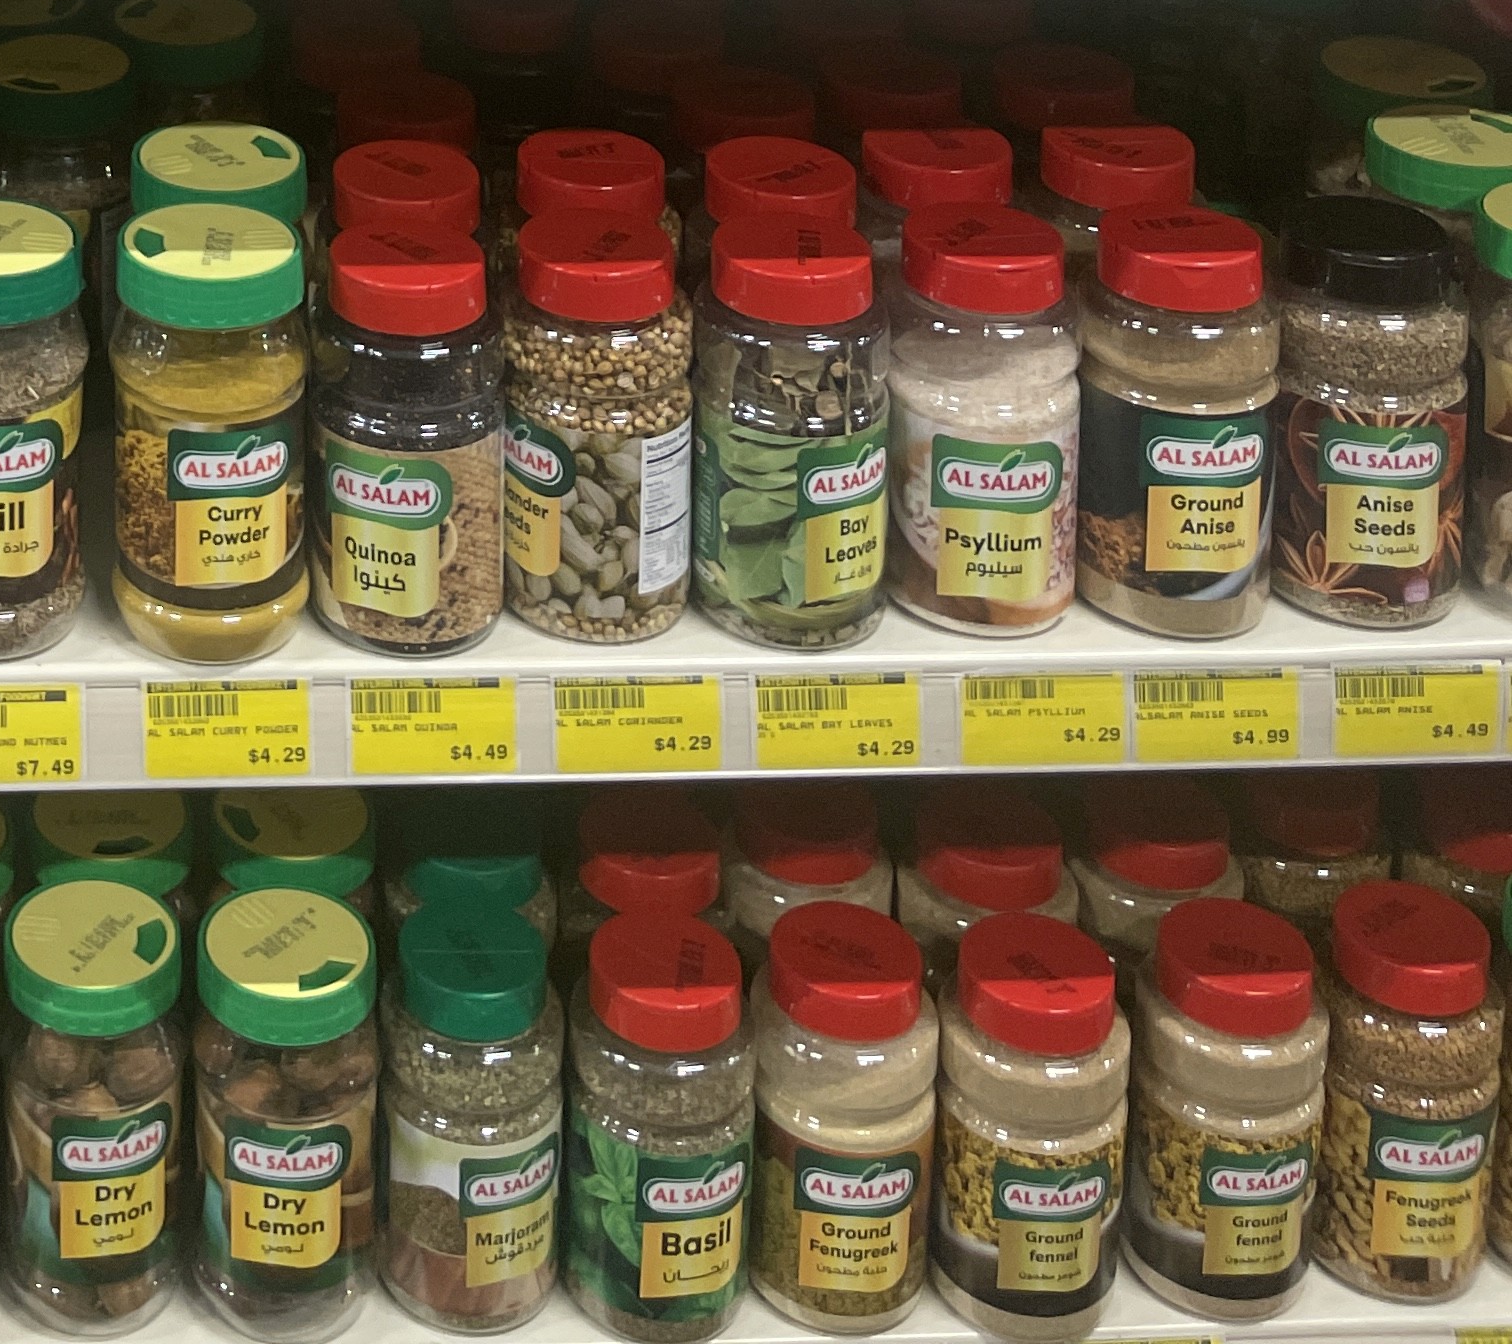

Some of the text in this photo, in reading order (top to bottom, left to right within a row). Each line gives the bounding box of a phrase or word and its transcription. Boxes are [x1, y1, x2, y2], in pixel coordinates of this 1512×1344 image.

[1357, 494, 1415, 514] Anise
[839, 514, 870, 539] Bay
[1354, 518, 1416, 538] Seeds
[344, 535, 417, 568] Quinoa
[825, 538, 878, 566] Leaves
[944, 526, 1043, 555] Psyllium
[353, 564, 407, 593] كينوا
[1432, 722, 1489, 740] $4.49
[16, 757, 74, 778] $7.49
[95, 1180, 136, 1205] Dry
[74, 1201, 154, 1228] Lemon
[660, 1219, 732, 1257] Basil
[820, 1221, 891, 1240] Ground
[809, 1239, 900, 1261] Fenugreek
